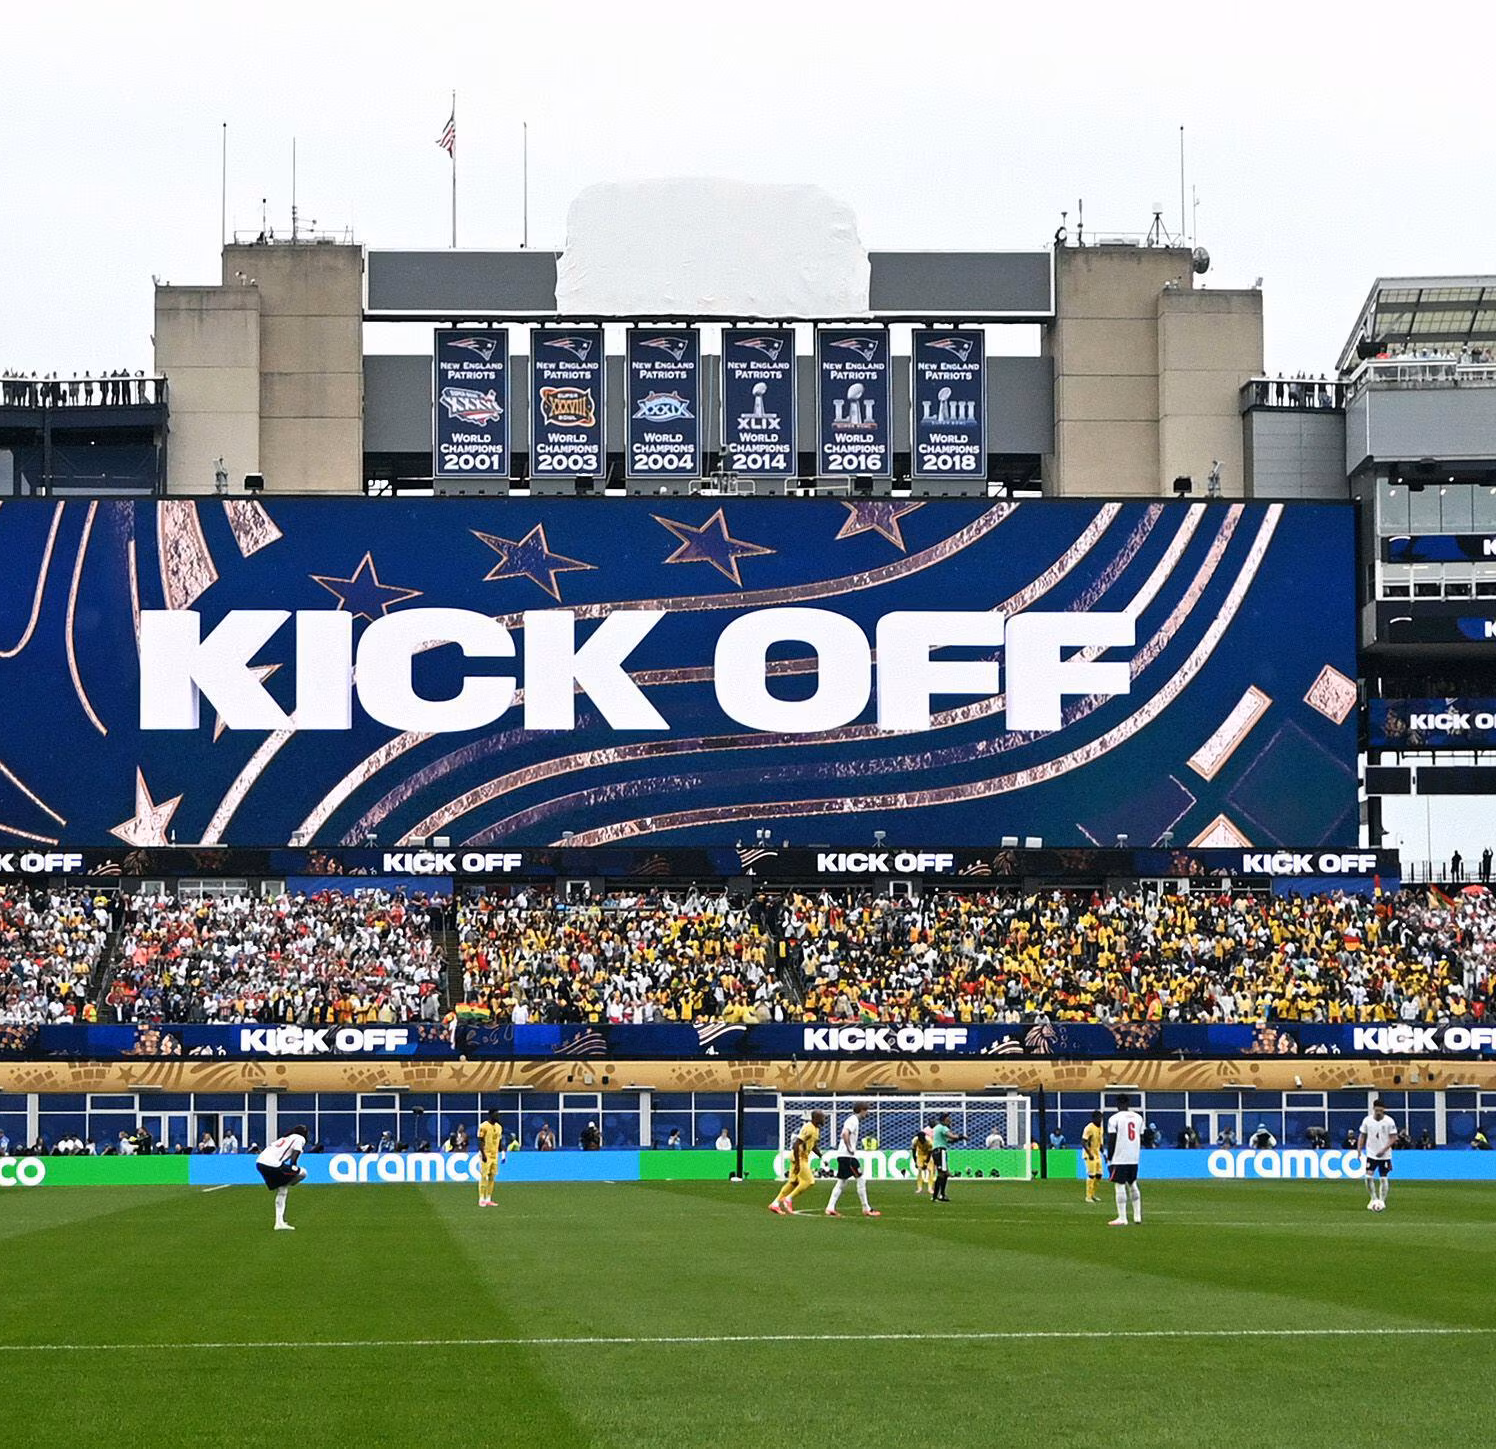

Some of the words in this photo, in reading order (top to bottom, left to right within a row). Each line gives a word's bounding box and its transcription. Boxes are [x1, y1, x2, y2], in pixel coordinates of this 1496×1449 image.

[447, 371, 496, 379] PATRIOTS
[544, 371, 591, 379] PATRIOTS
[639, 371, 687, 379] PATRIOTS
[735, 371, 782, 379] PATRIOTS
[830, 371, 877, 379] PATRIOTS
[925, 371, 973, 379] PATRIOTS
[737, 418, 781, 429] XLIX
[451, 433, 492, 442] WORLD
[547, 433, 587, 442] WORLD
[644, 433, 683, 442] WORLD
[739, 433, 779, 442] WORLD
[834, 433, 874, 442] WORLD
[929, 433, 969, 442] WORLD
[440, 443, 503, 453] CHAMPIONS
[536, 443, 598, 453] CHAMPIONS
[632, 443, 695, 453] CHAMPIONS
[728, 443, 790, 453] CHAMPIONS
[824, 443, 885, 453] CHAMPIONS
[918, 443, 980, 453] CHAMPIONS
[444, 454, 500, 470] 2001
[537, 454, 598, 470] 2003
[633, 454, 694, 470] 2004
[732, 454, 787, 470] 2014
[828, 454, 882, 470] 2016
[923, 454, 976, 470] 2018
[139, 609, 666, 732] KICK
[714, 607, 1138, 732] OFF
[1411, 714, 1470, 729] KICK
[21, 853, 82, 872] OFF
[384, 853, 456, 872] KICK
[463, 854, 521, 871] OFF
[818, 854, 889, 871] KICK
[895, 853, 953, 872] OFF
[1244, 854, 1313, 874] KICK
[1319, 855, 1376, 872] OFF
[241, 1028, 329, 1053] KICK
[336, 1029, 408, 1051] OFF
[805, 1028, 890, 1050] KICK
[895, 1027, 967, 1052] OFF
[1354, 1027, 1438, 1051] KICK
[1127, 1121, 1136, 1141] 6
[1208, 1149, 1367, 1179] aramco
